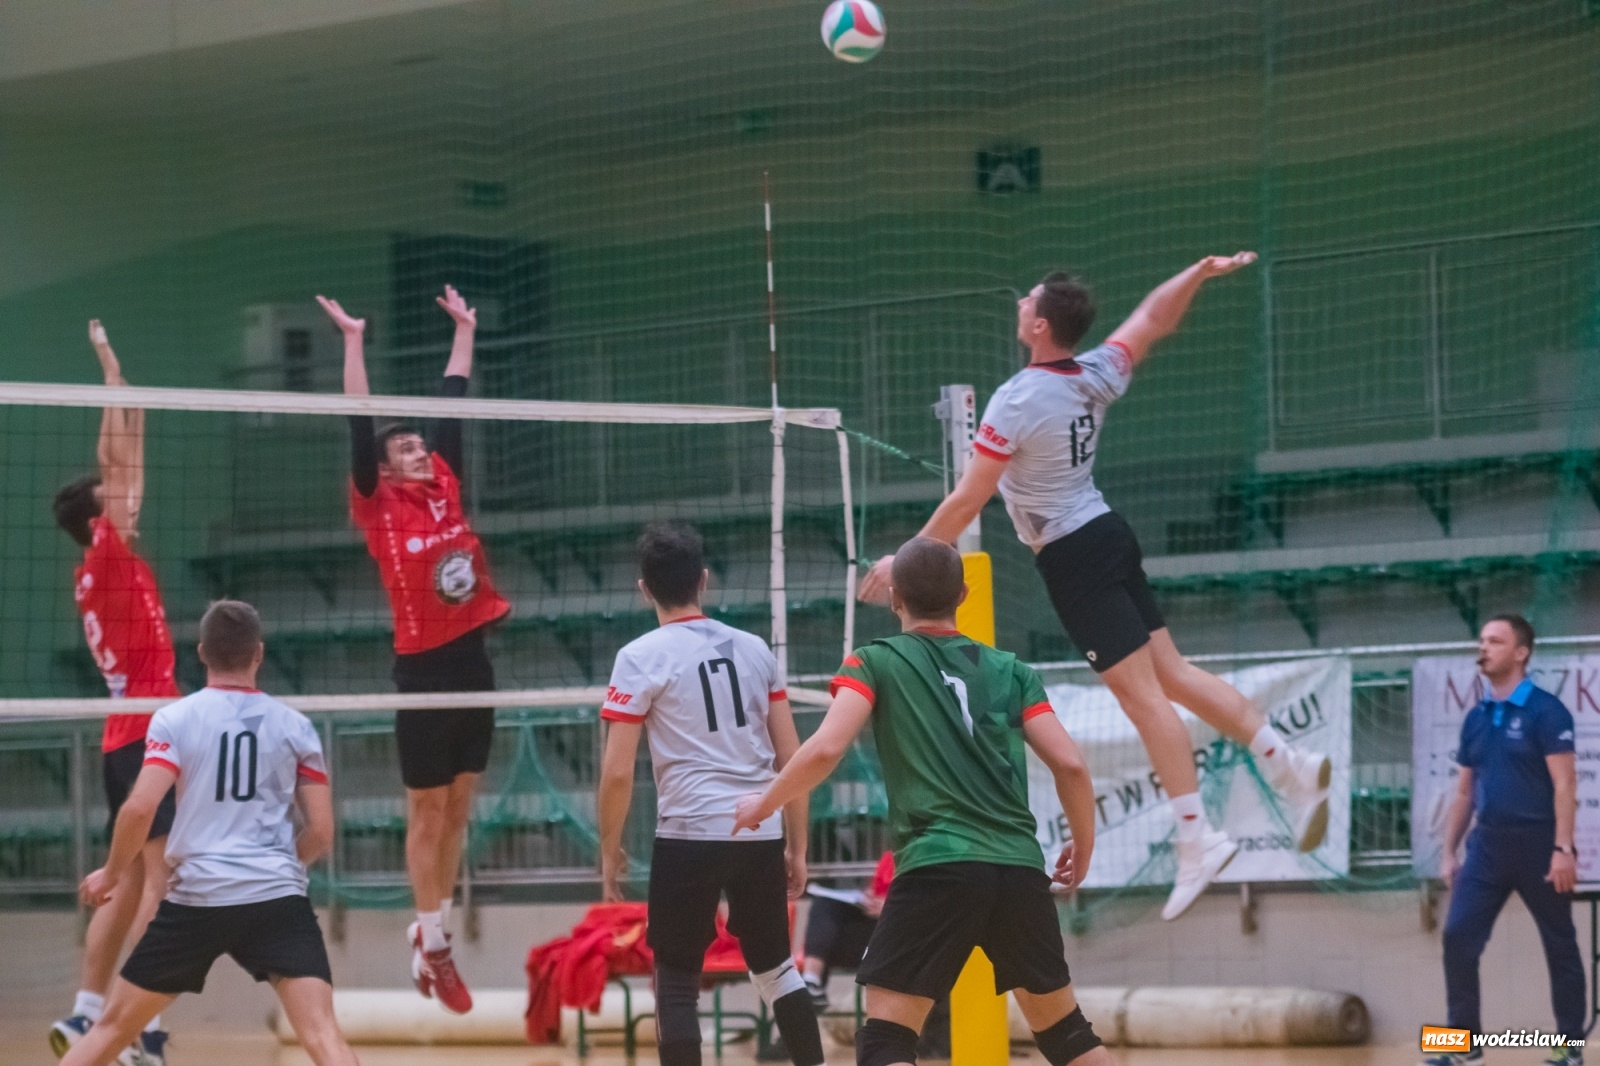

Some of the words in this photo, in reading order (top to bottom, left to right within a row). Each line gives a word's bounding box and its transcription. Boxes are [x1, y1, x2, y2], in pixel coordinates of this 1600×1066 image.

[1070, 414, 1096, 468] 12
[698, 657, 747, 732] 17
[215, 730, 258, 802] 10
